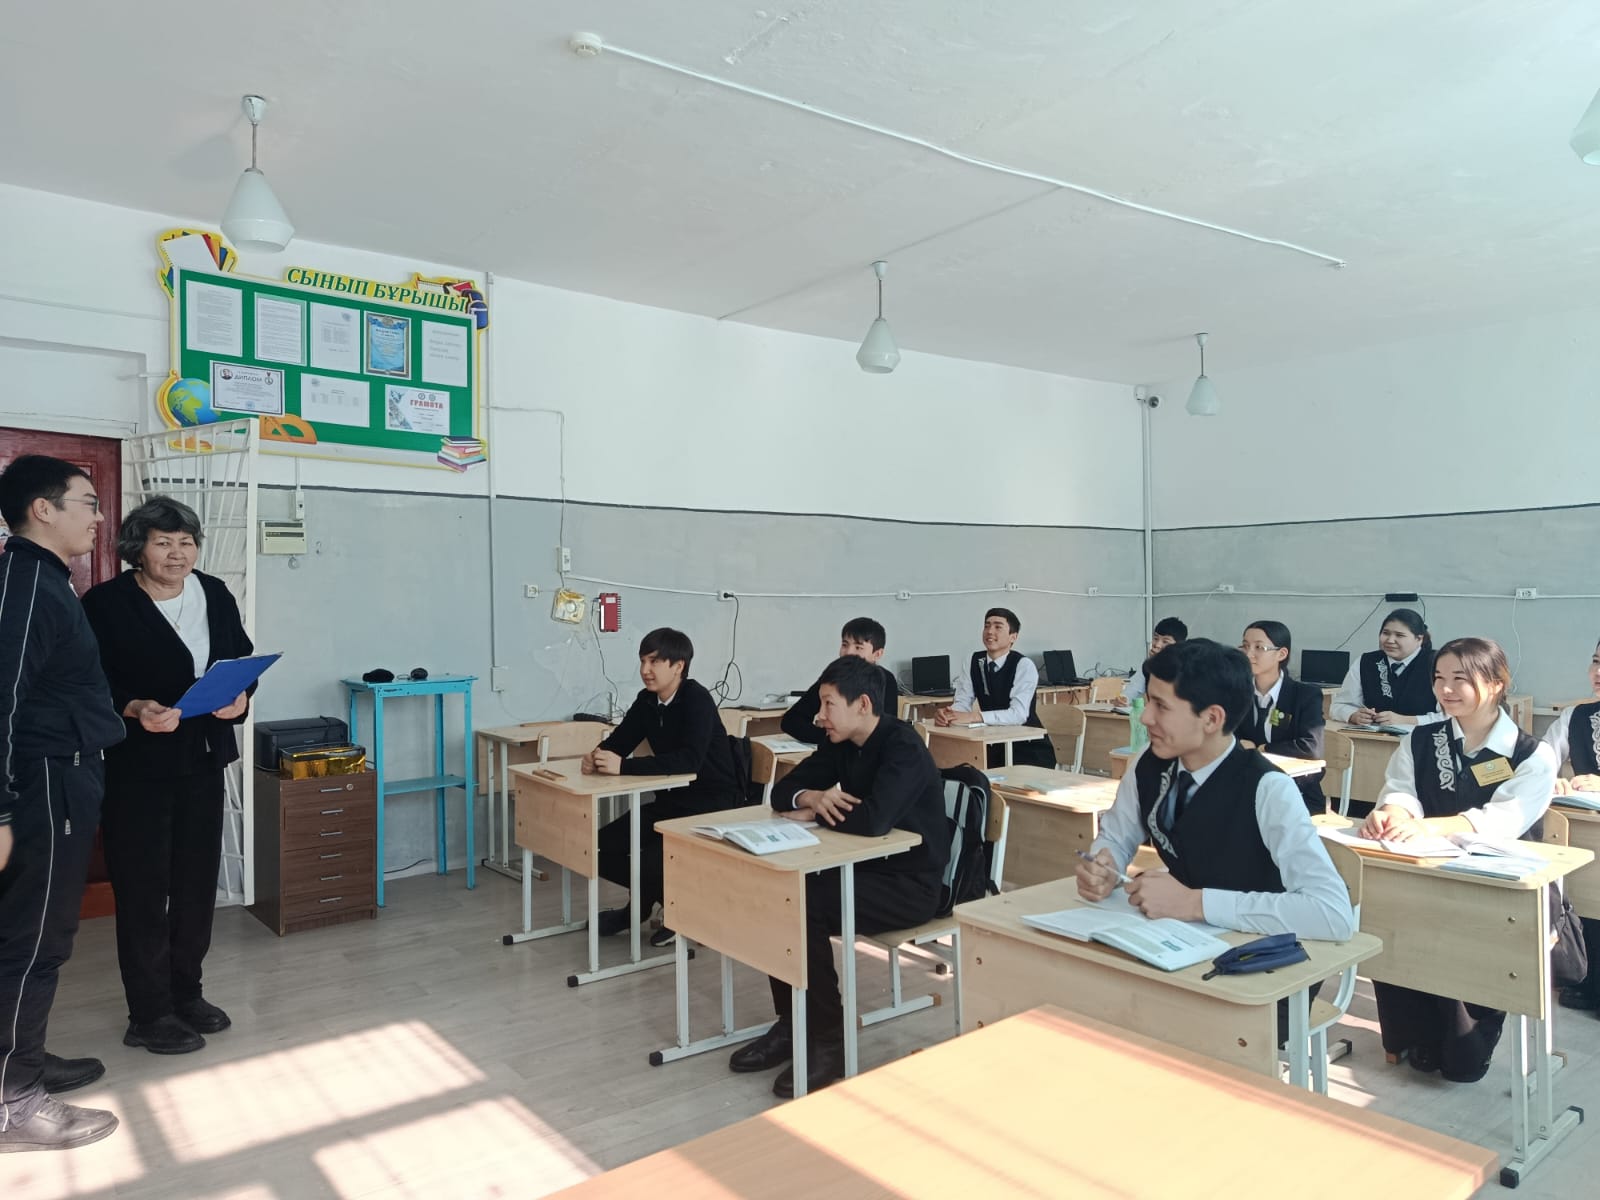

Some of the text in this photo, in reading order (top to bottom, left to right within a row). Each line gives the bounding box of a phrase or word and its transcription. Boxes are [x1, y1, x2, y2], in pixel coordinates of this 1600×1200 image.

[287, 268, 466, 312] СЫНЫП БҰРЫШЫ
[234, 374, 262, 382] ДИПЛОМ
[410, 400, 443, 409] ГРАМОТА
